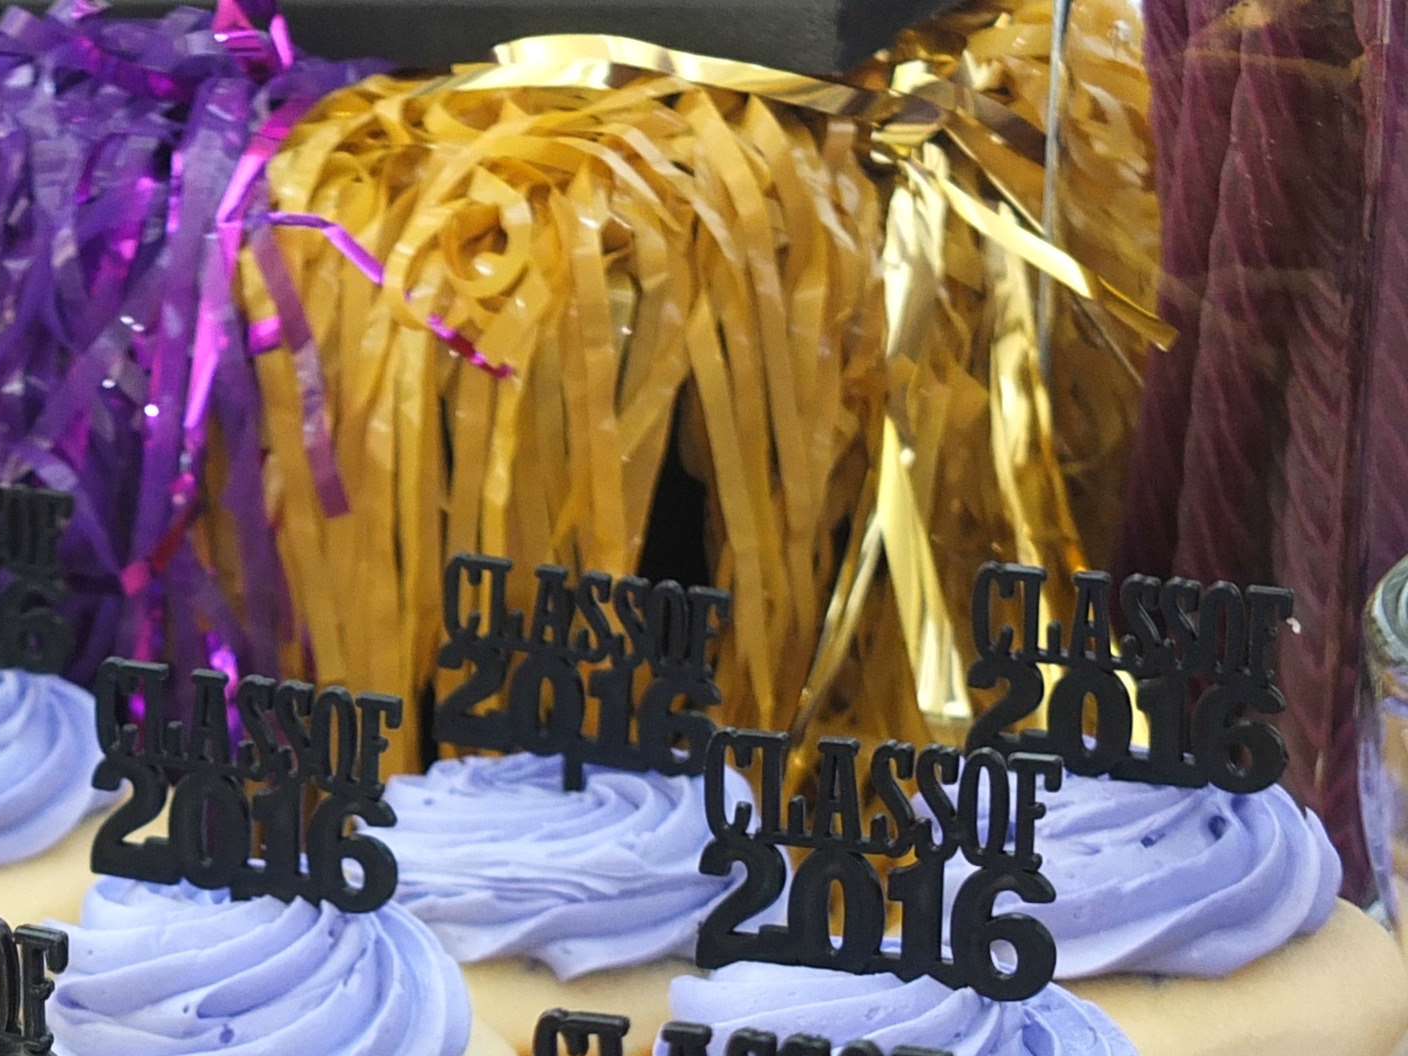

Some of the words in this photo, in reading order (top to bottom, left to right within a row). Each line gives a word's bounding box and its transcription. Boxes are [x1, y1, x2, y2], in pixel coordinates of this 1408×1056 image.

[433, 643, 721, 776] 2016
[966, 658, 1288, 793] 2016
[90, 756, 398, 913] 2016
[696, 836, 1056, 1000] 2016
